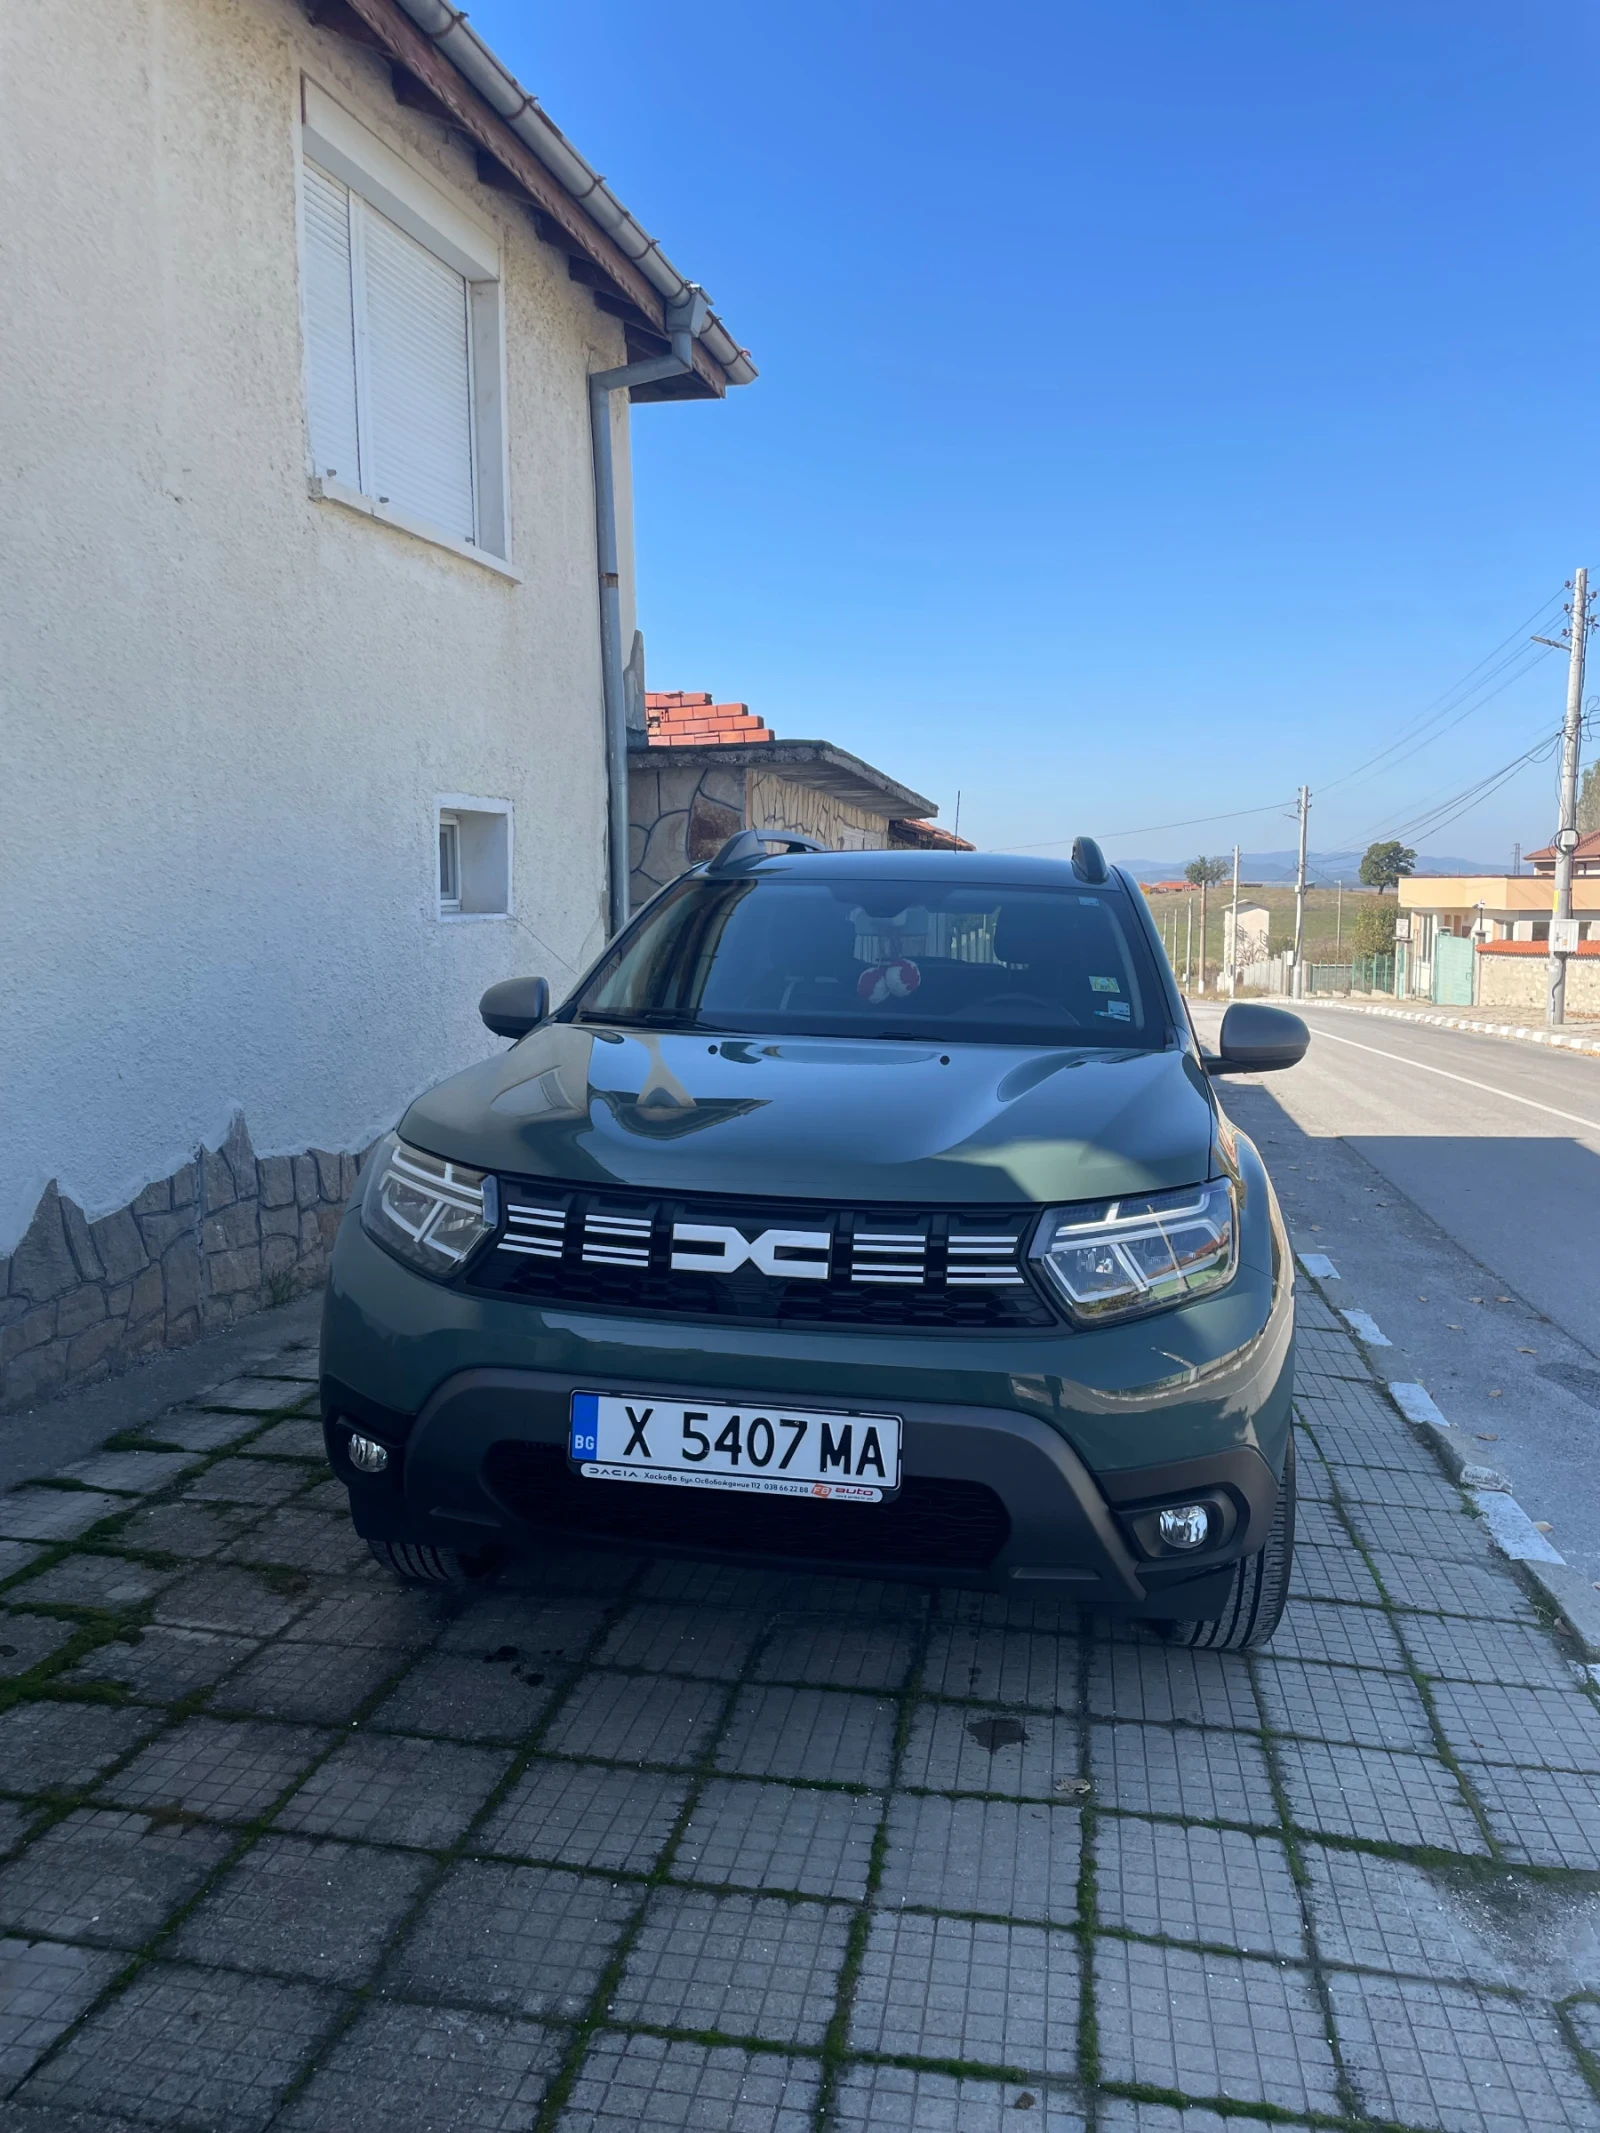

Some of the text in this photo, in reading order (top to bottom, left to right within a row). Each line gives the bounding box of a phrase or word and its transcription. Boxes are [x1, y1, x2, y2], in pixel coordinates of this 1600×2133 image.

[574, 1434, 595, 1451] BG
[623, 1406, 886, 1478] X 5407 MA
[589, 1467, 638, 1477] DACIA
[644, 1472, 677, 1482] Хасково
[764, 1483, 778, 1491] 038
[835, 1487, 874, 1496] auto
